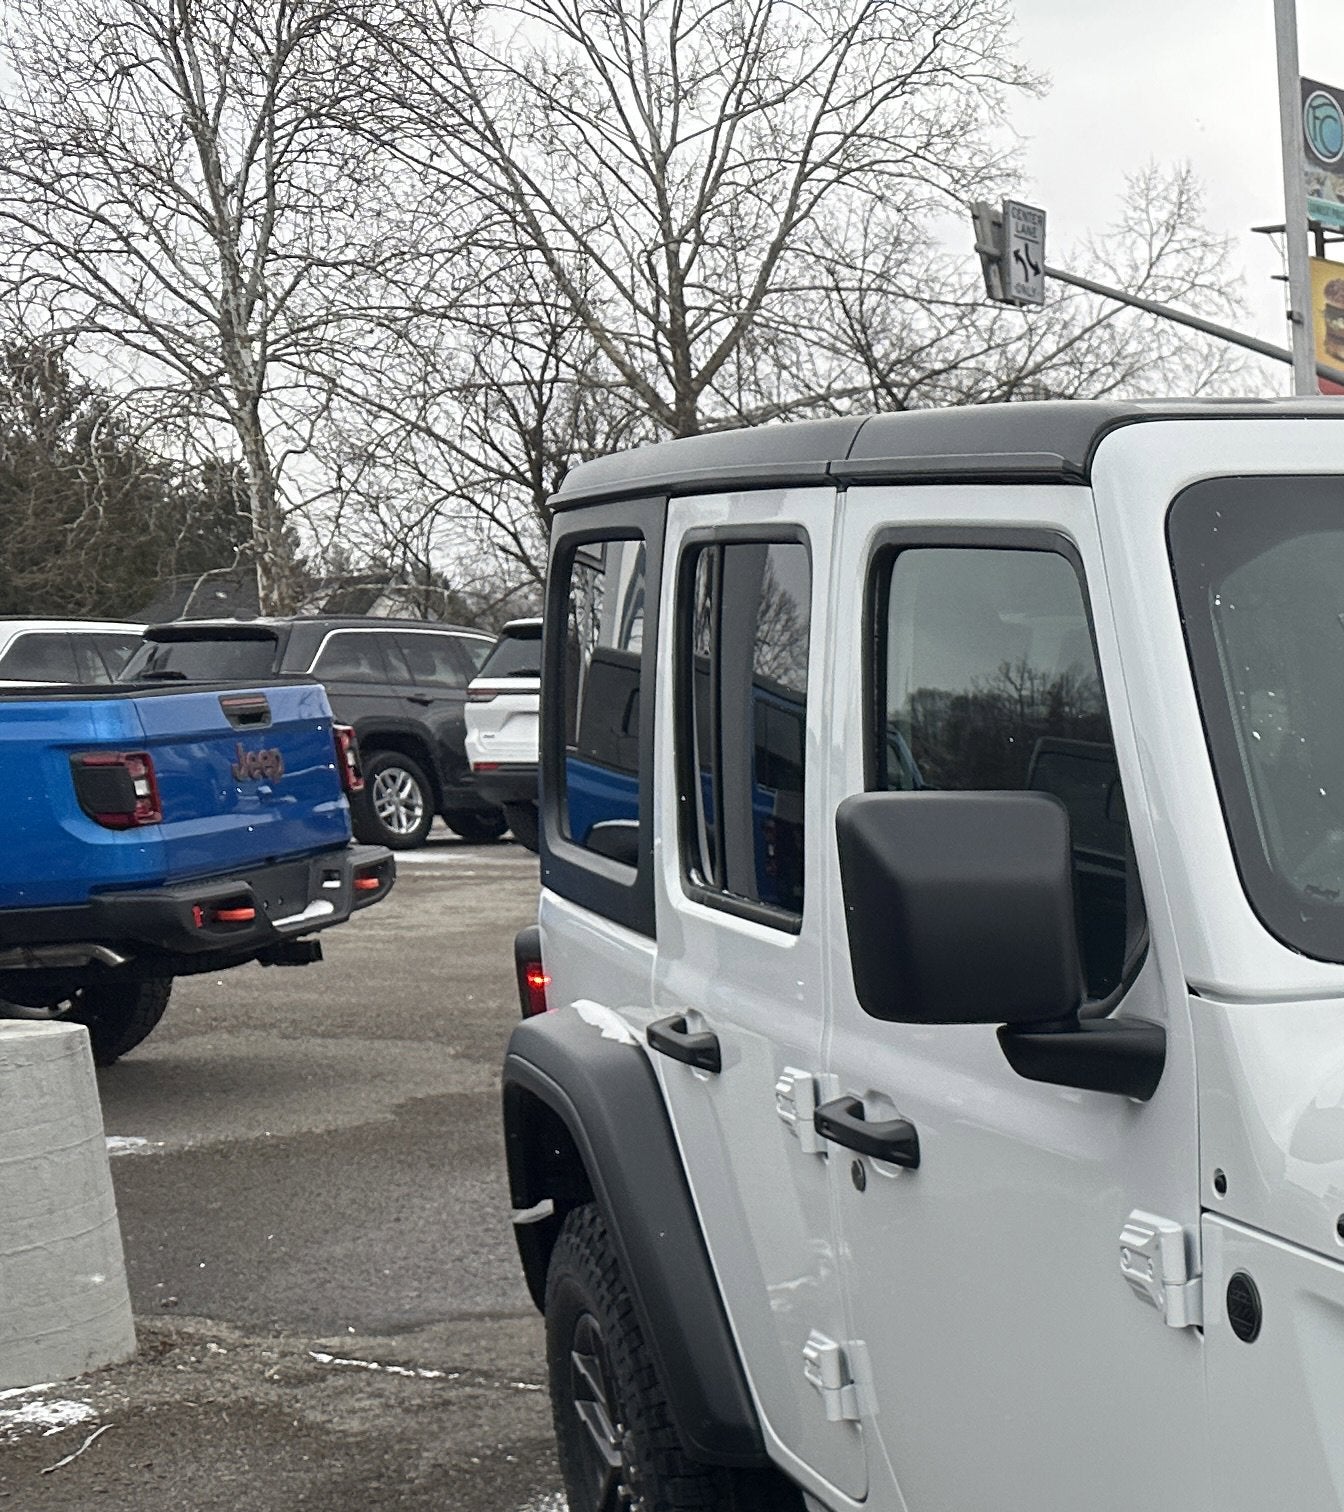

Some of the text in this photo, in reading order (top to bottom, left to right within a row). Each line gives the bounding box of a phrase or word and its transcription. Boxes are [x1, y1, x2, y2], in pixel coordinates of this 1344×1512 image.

[1011, 206, 1043, 226] CENTER
[1016, 221, 1038, 239] LANE
[1015, 282, 1037, 298] ONLY
[231, 742, 284, 785] Jeep
